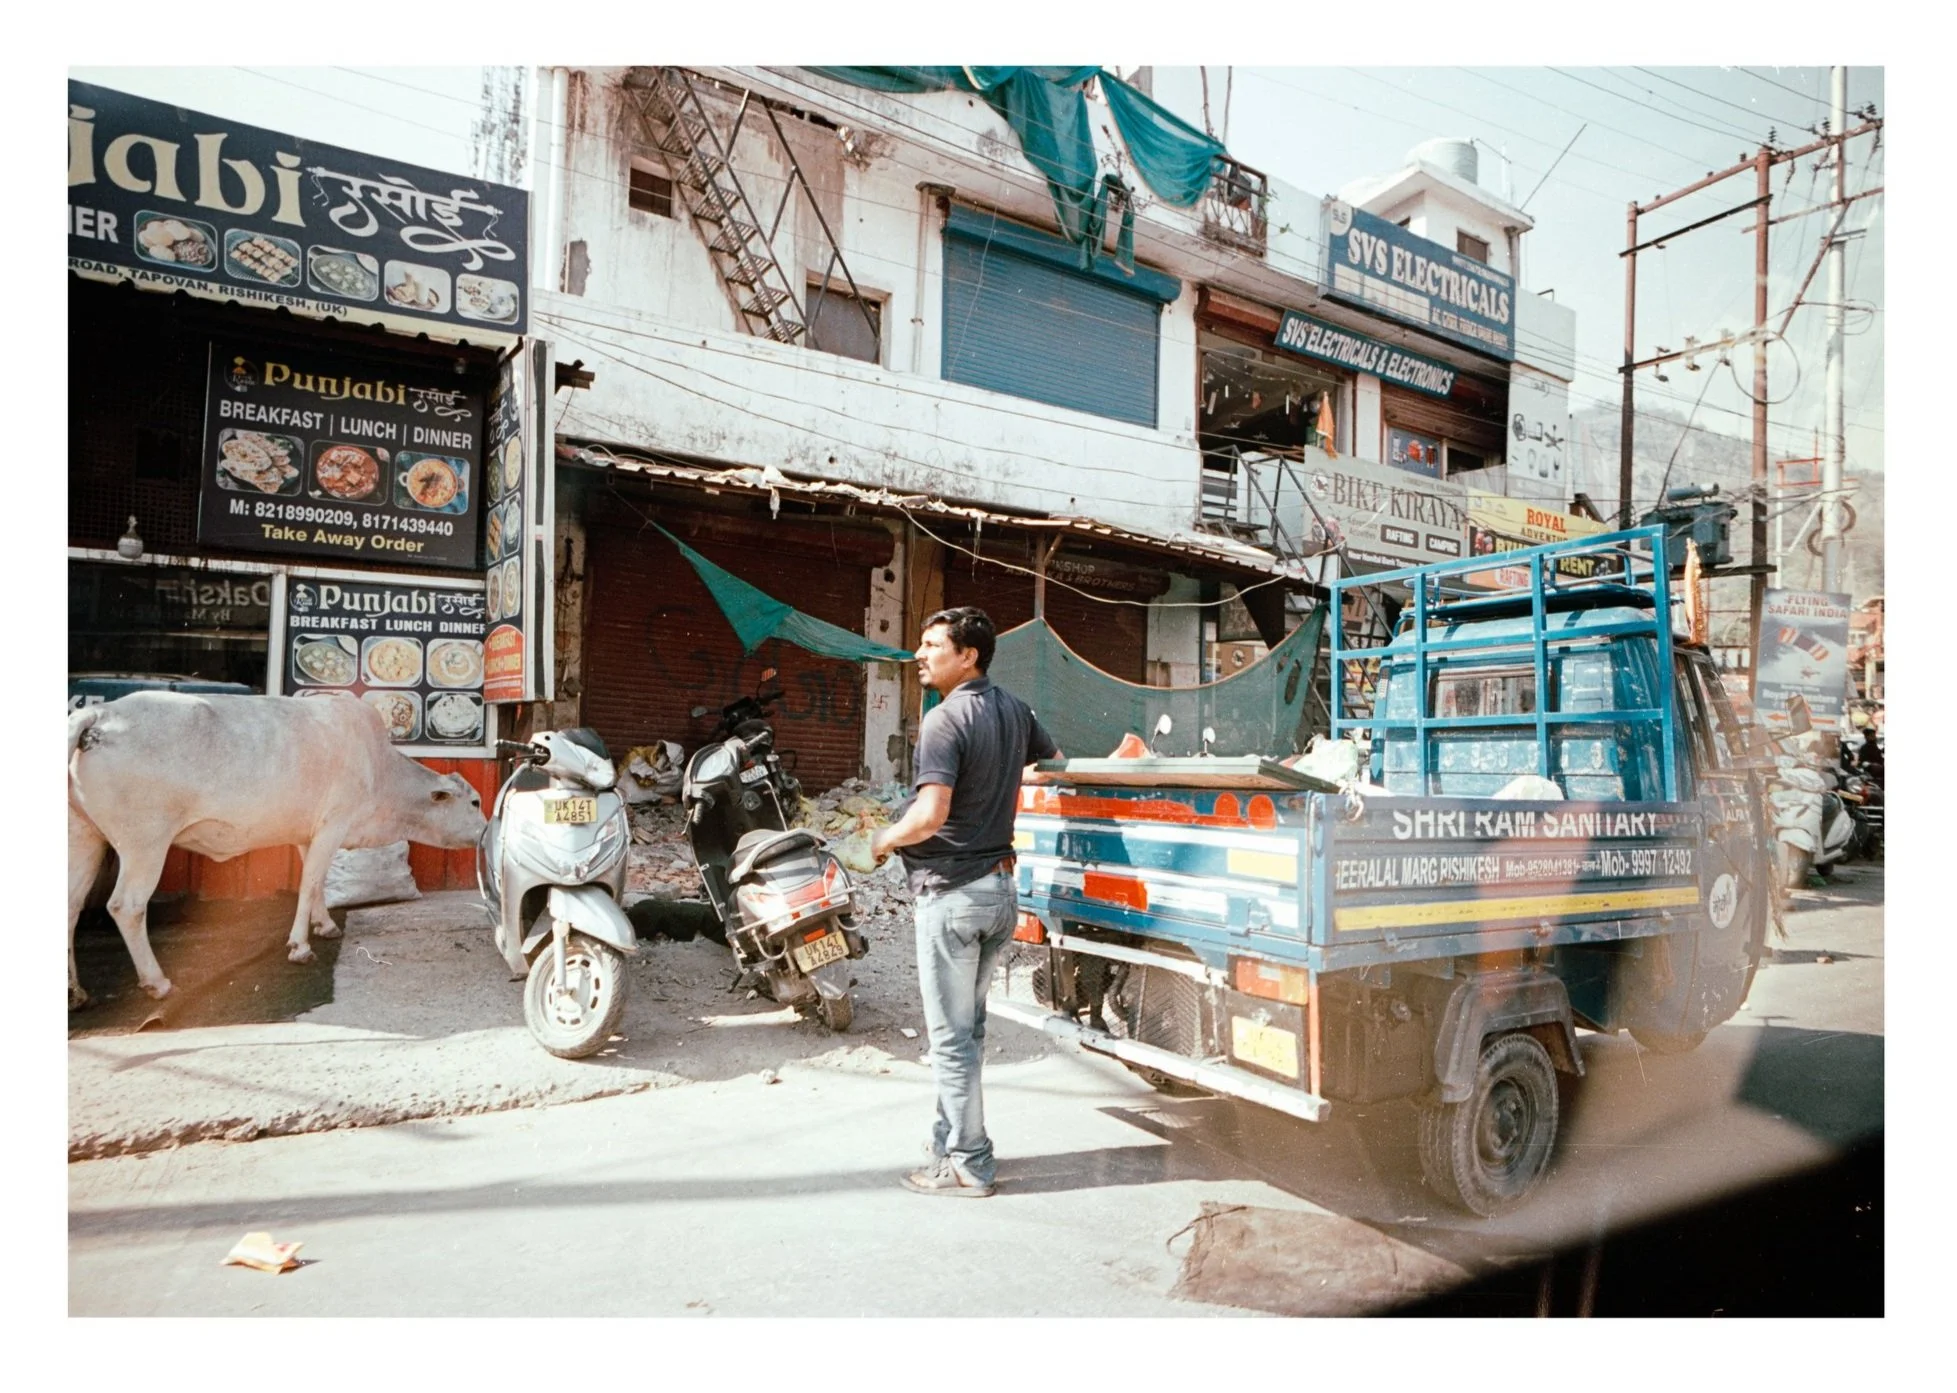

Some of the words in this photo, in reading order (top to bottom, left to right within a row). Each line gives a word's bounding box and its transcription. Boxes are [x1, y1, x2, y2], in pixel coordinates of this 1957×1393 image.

[1347, 227, 1388, 276] SVS
[1391, 245, 1510, 325] ELECTRICALS
[129, 268, 213, 294] TAPOVAN,
[219, 285, 311, 311] RISHIKESH,
[315, 301, 348, 317] (UK)
[1281, 316, 1307, 348] SVS
[1304, 322, 1380, 373] ELECTRICALS
[1376, 350, 1387, 374] &
[1385, 355, 1455, 396] ELECTRONICS
[264, 361, 407, 406] Punjabi
[219, 399, 324, 430] BREAKFAST
[340, 416, 397, 440] LUNCH
[413, 426, 473, 450] DINNER
[1333, 471, 1383, 514] BIKE
[1391, 486, 1461, 532] KIRAYA
[229, 498, 250, 516] M:
[254, 501, 358, 529] 8218990209,
[362, 515, 454, 537] 8171439440
[1527, 508, 1568, 534] ROYAL
[261, 523, 308, 542] Take
[312, 529, 366, 550] Away
[370, 534, 425, 553] Order
[1560, 556, 1595, 576] RENT
[319, 584, 437, 618] Punjabi
[1767, 605, 1810, 617] SAFARI
[1814, 607, 1848, 619] INDIA
[1787, 596, 1829, 607] FLYING
[290, 615, 379, 631] BREAKFAST
[385, 618, 433, 633] LUNCH
[554, 799, 592, 811] UK14T
[555, 811, 592, 823] A4851
[1392, 810, 1465, 840] SHRI
[1475, 810, 1536, 838] RAM
[1543, 811, 1658, 838] SANITARY
[1401, 857, 1438, 886] MARG
[804, 934, 839, 956] UK14T
